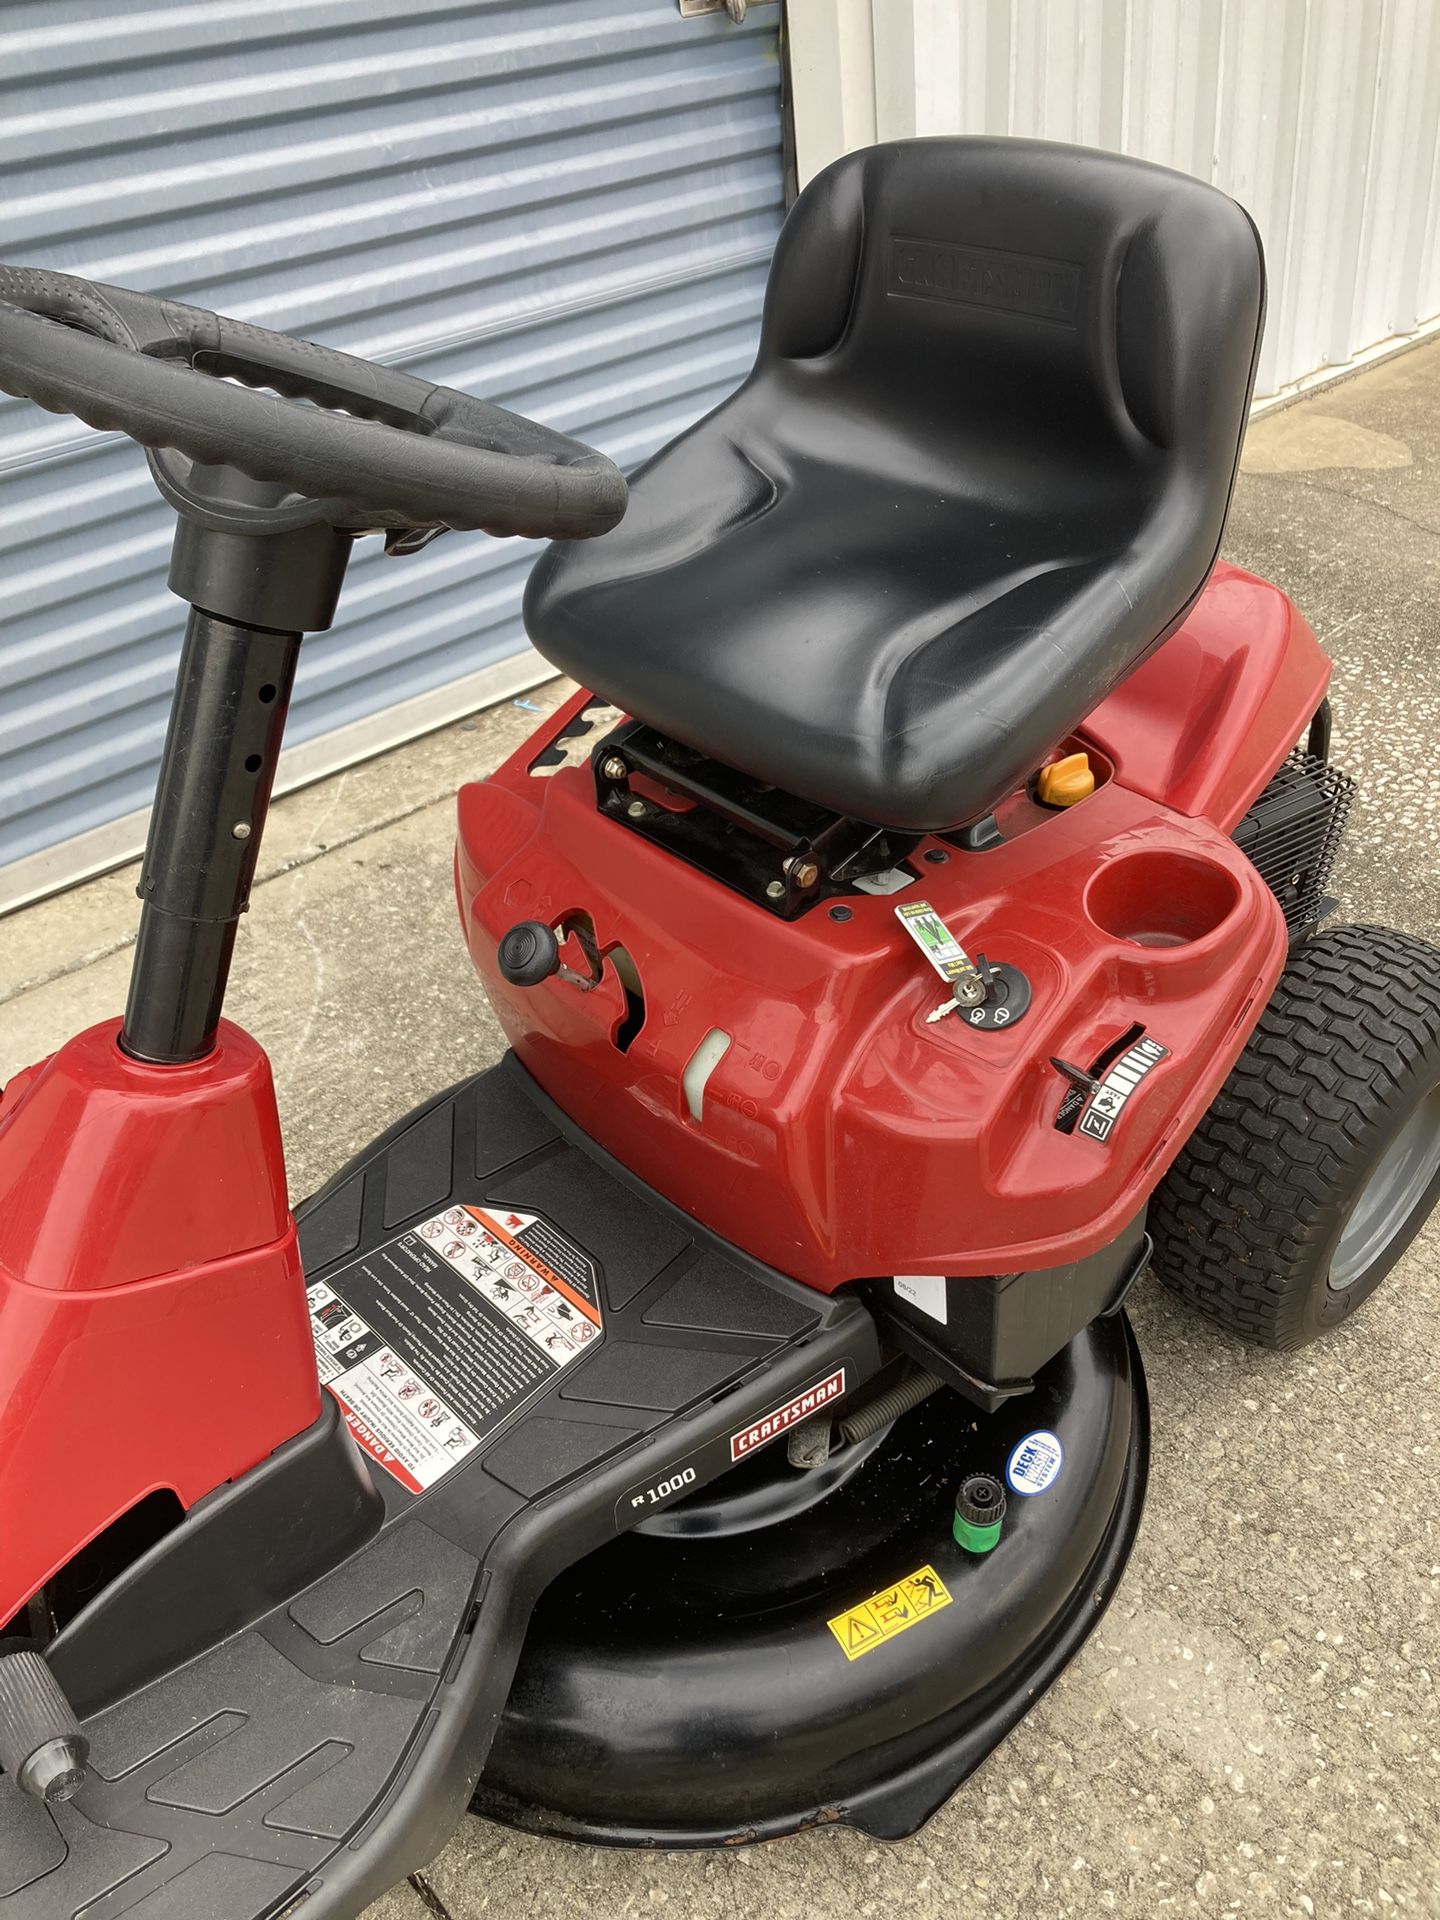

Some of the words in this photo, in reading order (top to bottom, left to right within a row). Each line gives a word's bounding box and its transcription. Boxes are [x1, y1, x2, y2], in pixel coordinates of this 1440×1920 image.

[508, 1239, 550, 1276] WARNING
[345, 1412, 385, 1454] DANGER
[738, 1379, 838, 1451] CRAFTSMAN
[1012, 1445, 1038, 1478] DECK
[1024, 1451, 1049, 1484] WASH
[1036, 1457, 1057, 1488] SYSTEM
[631, 1495, 645, 1508] R
[647, 1467, 697, 1504] 1000
